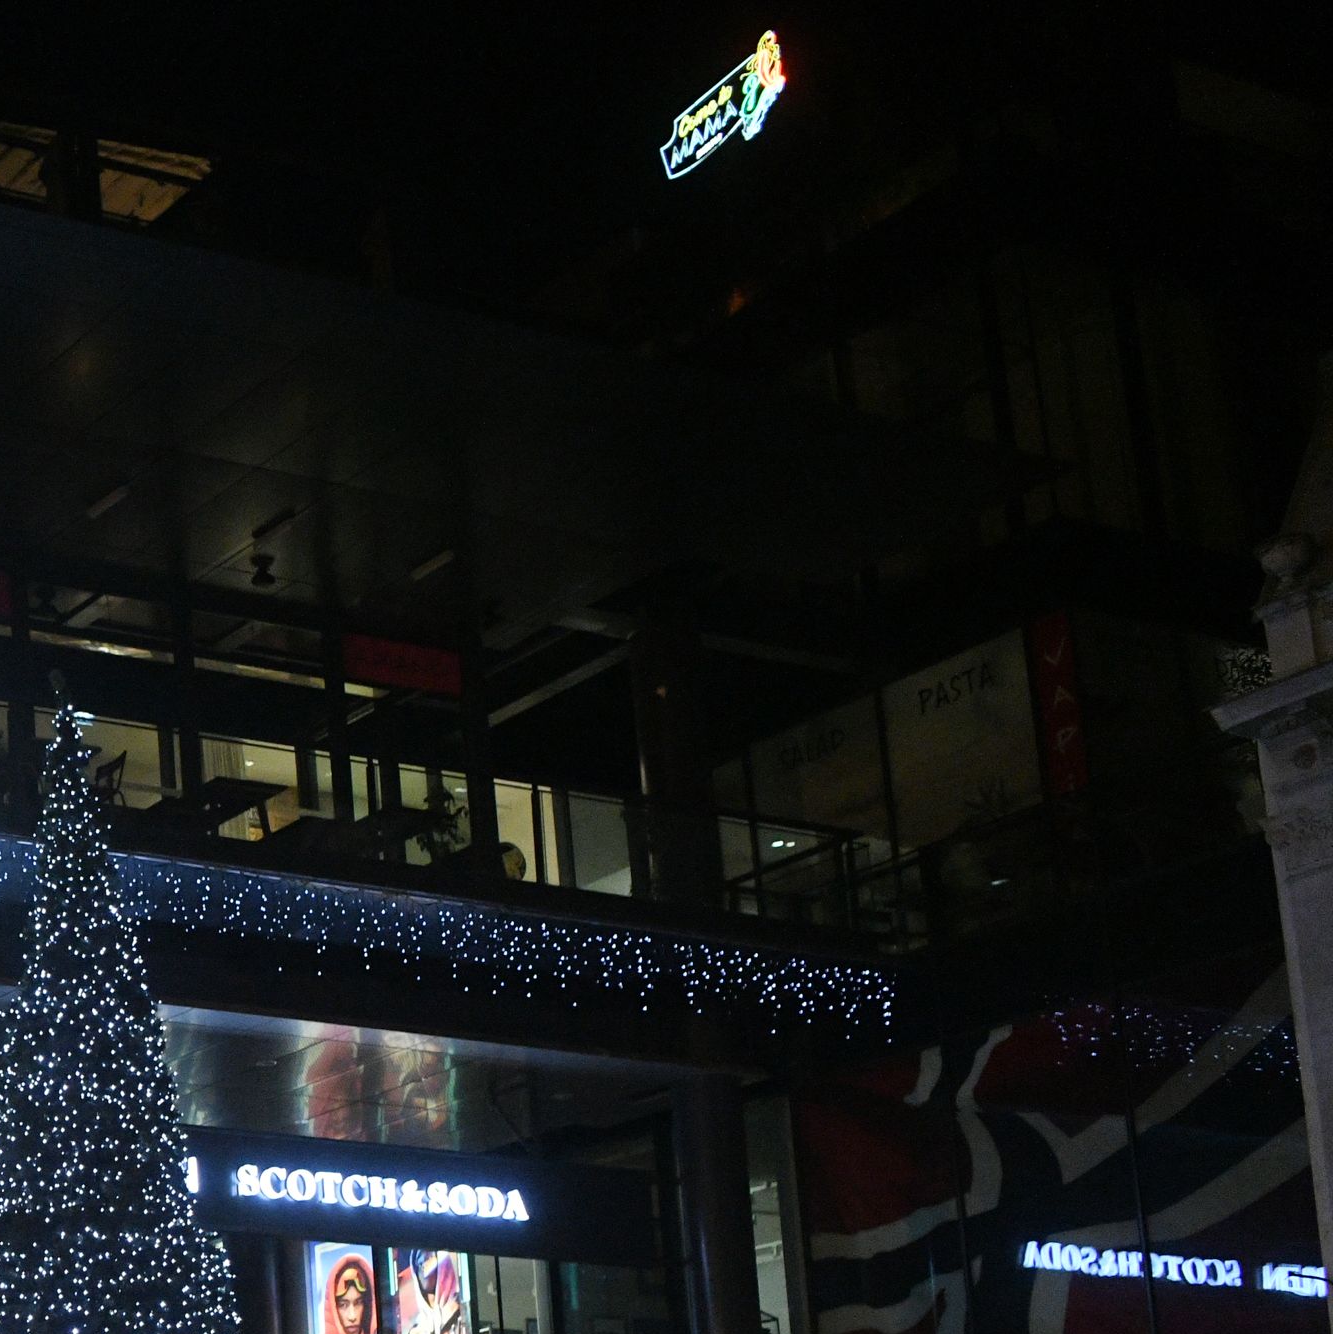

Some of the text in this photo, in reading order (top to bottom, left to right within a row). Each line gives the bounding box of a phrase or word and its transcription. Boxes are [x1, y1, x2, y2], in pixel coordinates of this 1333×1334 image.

[670, 100, 737, 168] MAMA
[918, 662, 995, 716] PASTA
[236, 1163, 530, 1221] SCOTCH&SODA
